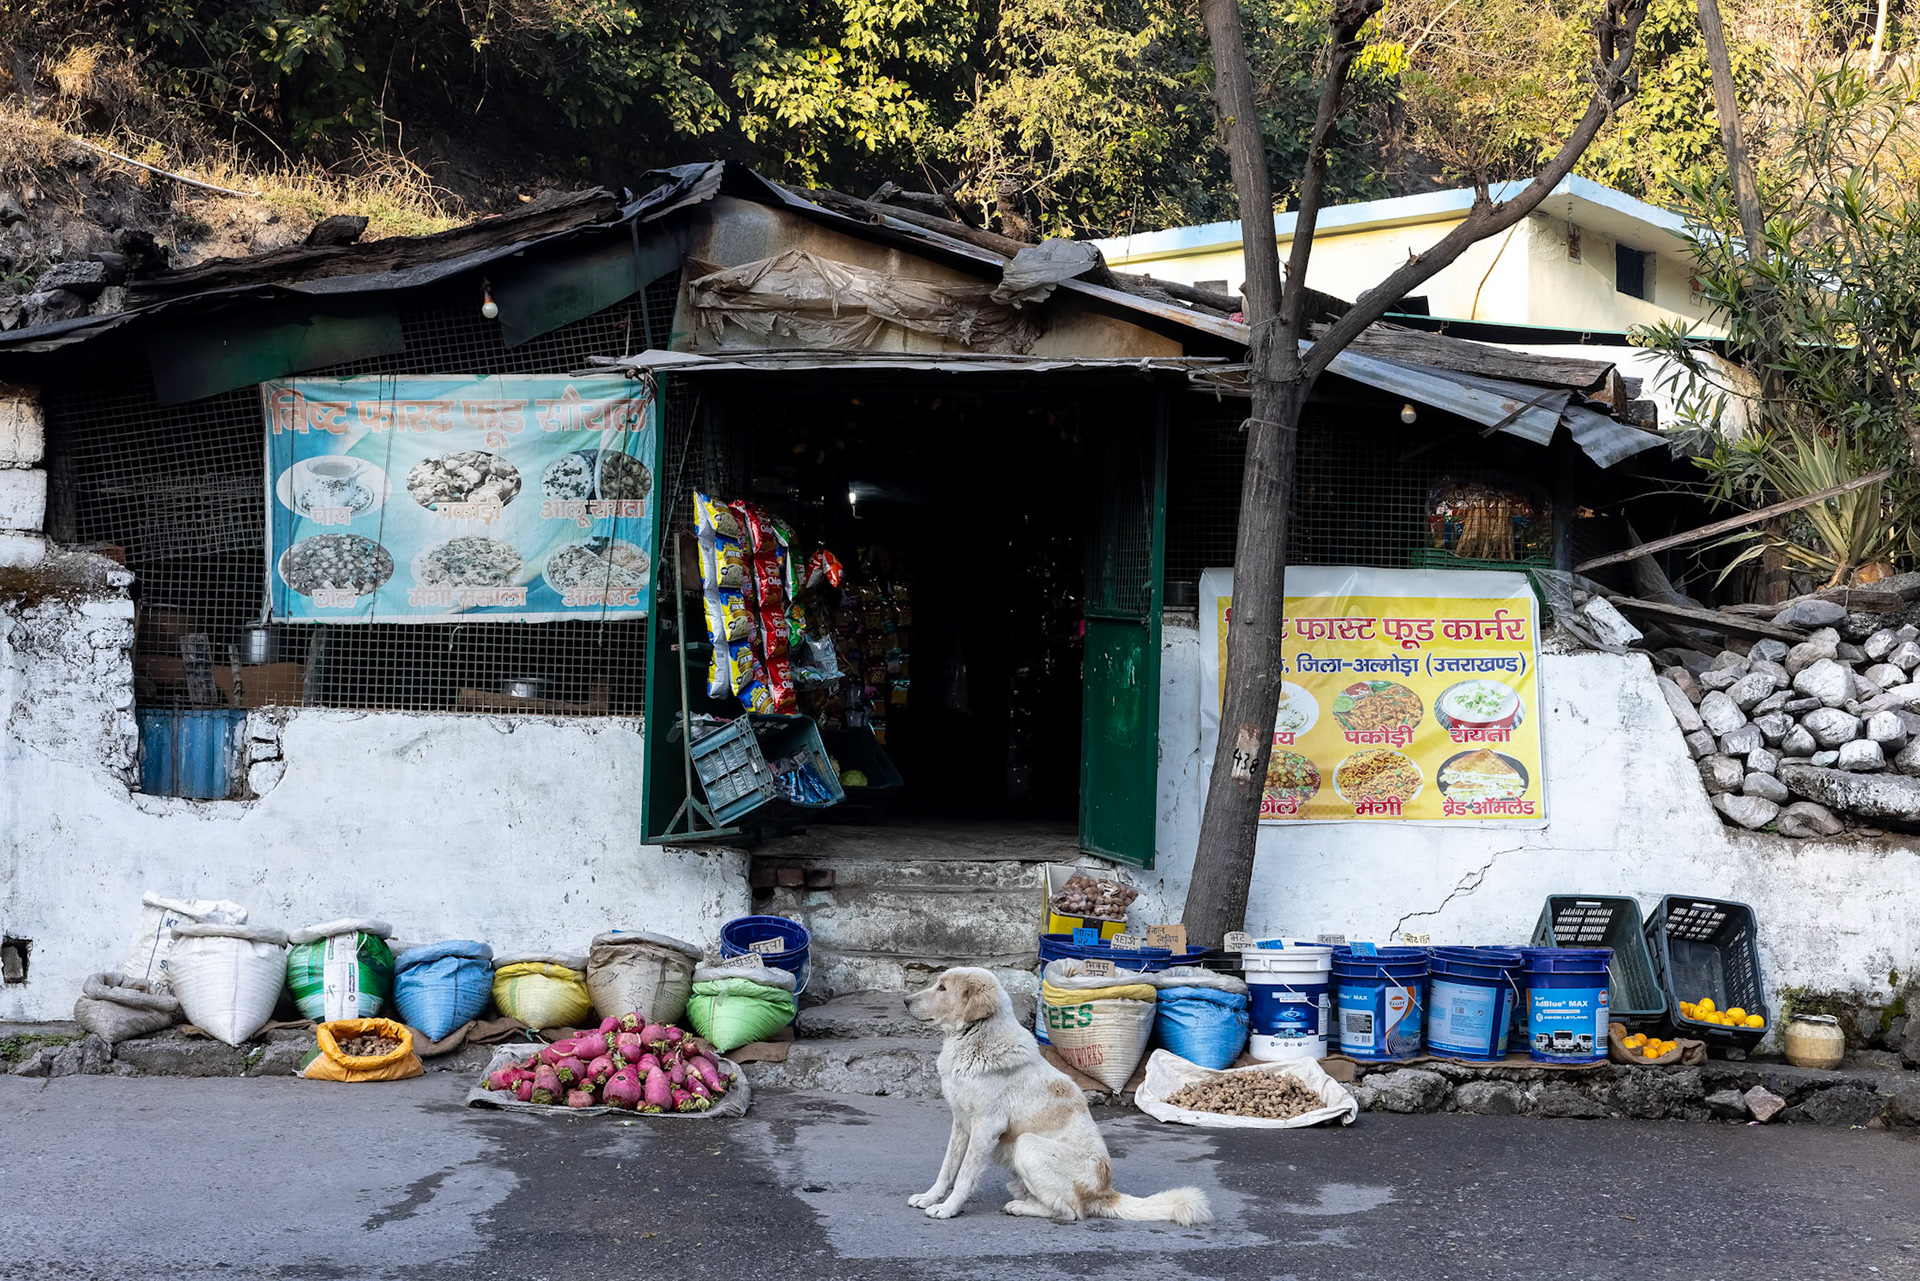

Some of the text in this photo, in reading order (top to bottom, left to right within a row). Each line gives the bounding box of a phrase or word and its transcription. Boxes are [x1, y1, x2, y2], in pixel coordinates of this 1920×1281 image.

[270, 387, 352, 435] बिष्ट
[357, 398, 456, 433] फास्ट
[460, 398, 528, 448] फूड
[310, 506, 353, 525] चाय
[541, 499, 646, 528] आलू रायता
[312, 586, 359, 608] छोले
[408, 583, 457, 608] मैगी
[1296, 618, 1376, 641] फास्ट
[1383, 618, 1436, 649] फूड
[1441, 609, 1527, 641] कार्नर
[1296, 653, 1419, 677] जिला-अल्मोड़ा
[1425, 652, 1526, 677] (उत्तराखण्ड)
[1344, 725, 1414, 749] पकौड़ी
[1450, 728, 1512, 744] रायता
[1233, 748, 1259, 775] 438
[1355, 796, 1403, 816] मैगी
